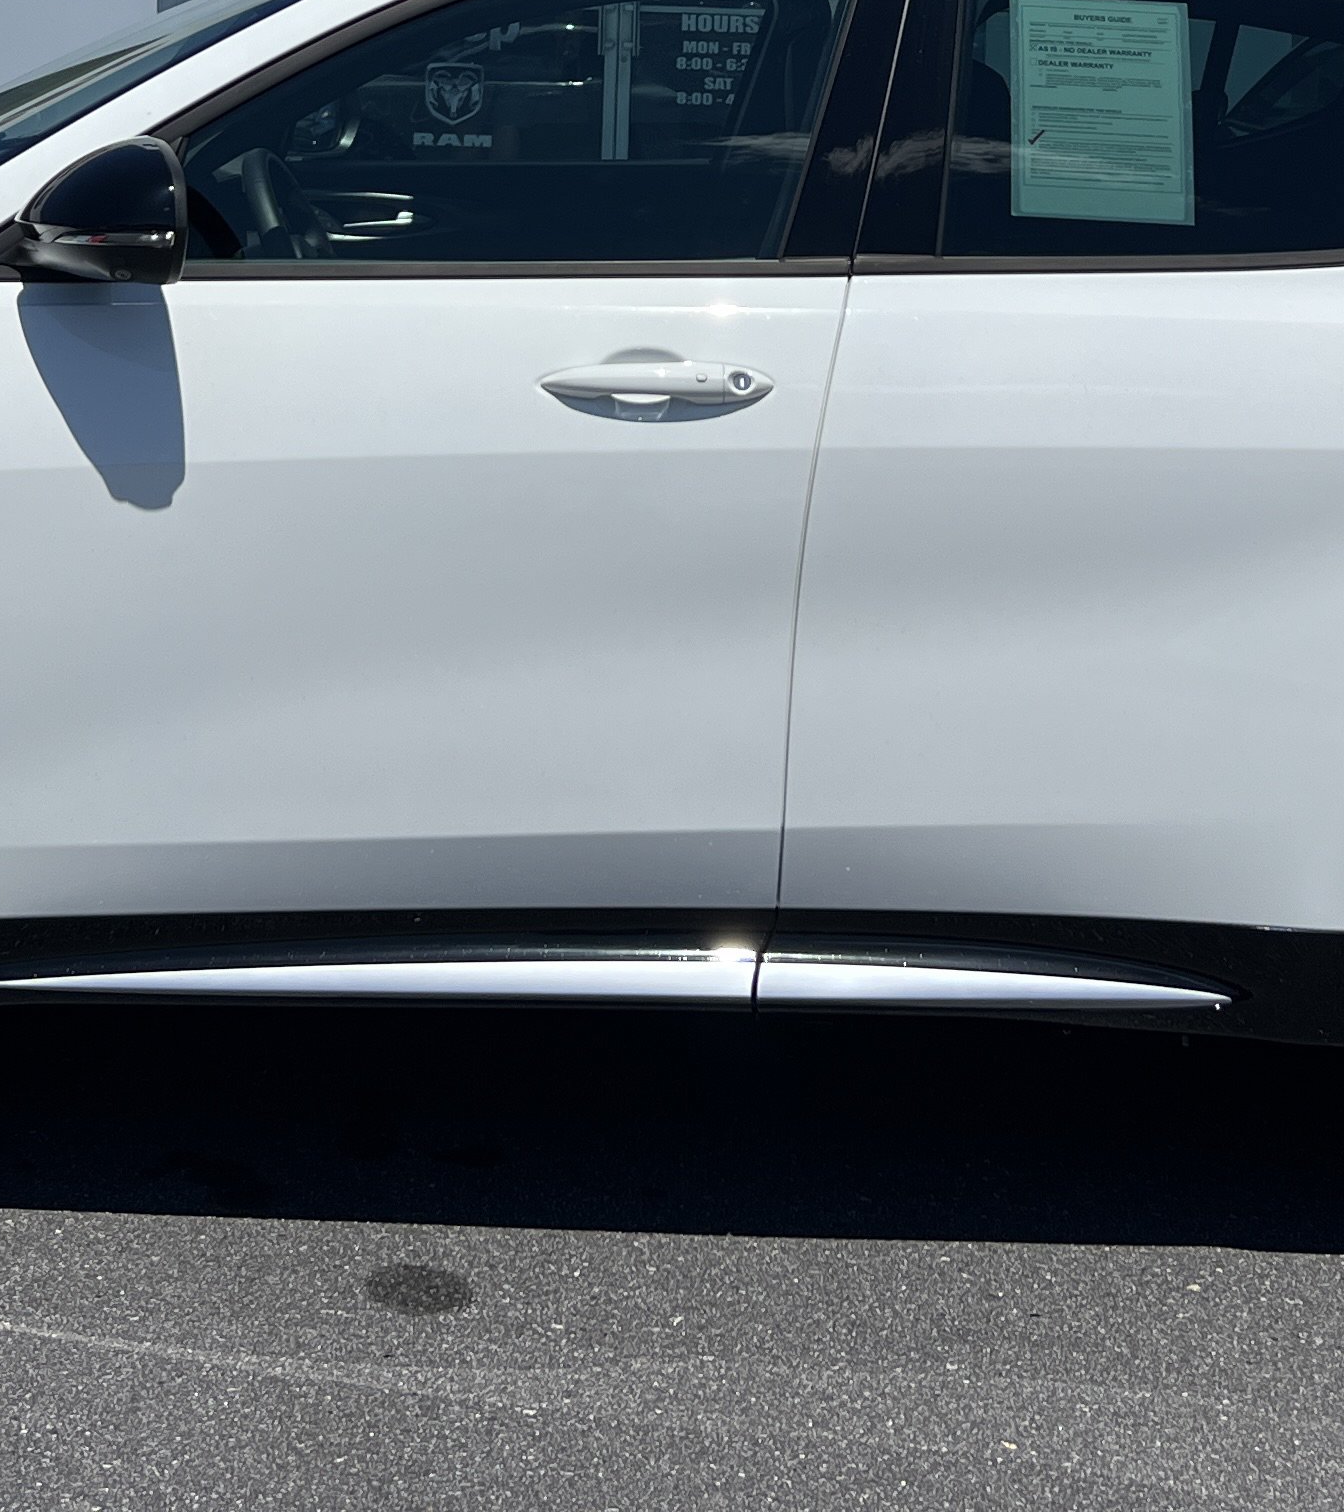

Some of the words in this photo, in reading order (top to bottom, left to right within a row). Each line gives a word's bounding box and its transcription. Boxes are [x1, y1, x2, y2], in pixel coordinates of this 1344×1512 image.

[681, 13, 760, 33] HOURS
[682, 40, 719, 54] MON
[732, 42, 752, 55] FR
[676, 56, 713, 70] 8:00
[704, 77, 734, 90] SAT
[676, 91, 713, 105] 8:00
[413, 132, 493, 148] RAM
